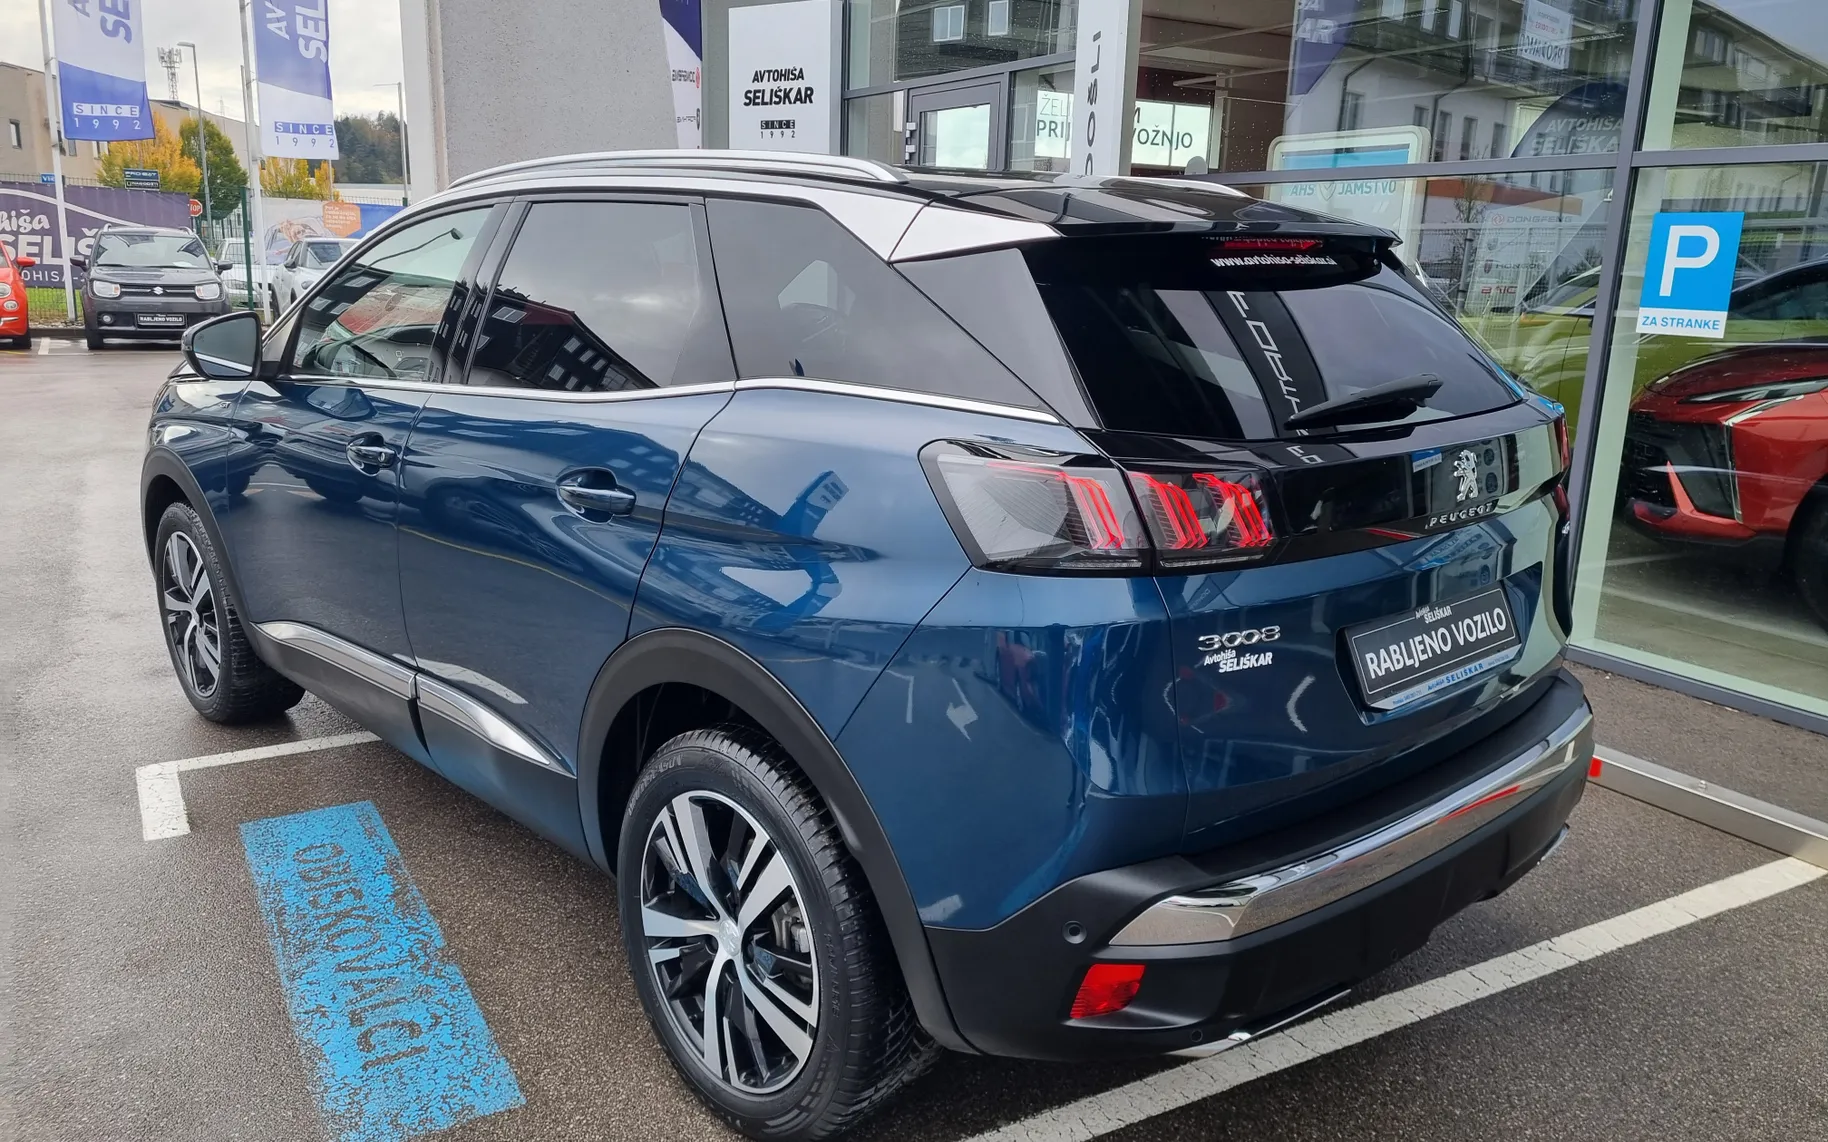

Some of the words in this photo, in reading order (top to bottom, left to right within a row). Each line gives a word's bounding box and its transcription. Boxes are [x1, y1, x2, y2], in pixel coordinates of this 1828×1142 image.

[752, 66, 805, 83] AVTOHIŠA
[743, 86, 814, 107] SELIŠKAR
[75, 104, 138, 116] SINCE
[74, 117, 141, 130] 1992
[275, 122, 334, 135] SINCE
[761, 120, 795, 129] SINCE
[275, 135, 335, 148] 1992
[760, 130, 796, 139] 1992
[1338, 179, 1397, 196] JAMSTVO
[1659, 225, 1720, 297] P
[1642, 315, 1657, 327] ZA
[1660, 316, 1721, 330] STRANKE
[1429, 502, 1493, 527] PEUGEOT
[1424, 605, 1452, 625] SELIŠKAR
[1198, 625, 1281, 651] 3008
[1365, 626, 1452, 680] RABLJENO
[1451, 607, 1507, 647] VOZILO
[1204, 648, 1236, 666] Avtohiša
[1219, 651, 1273, 673] SELIŠKAR
[1445, 662, 1485, 684] SELIŠKAR
[293, 842, 431, 1072] OBISKOVALCI
